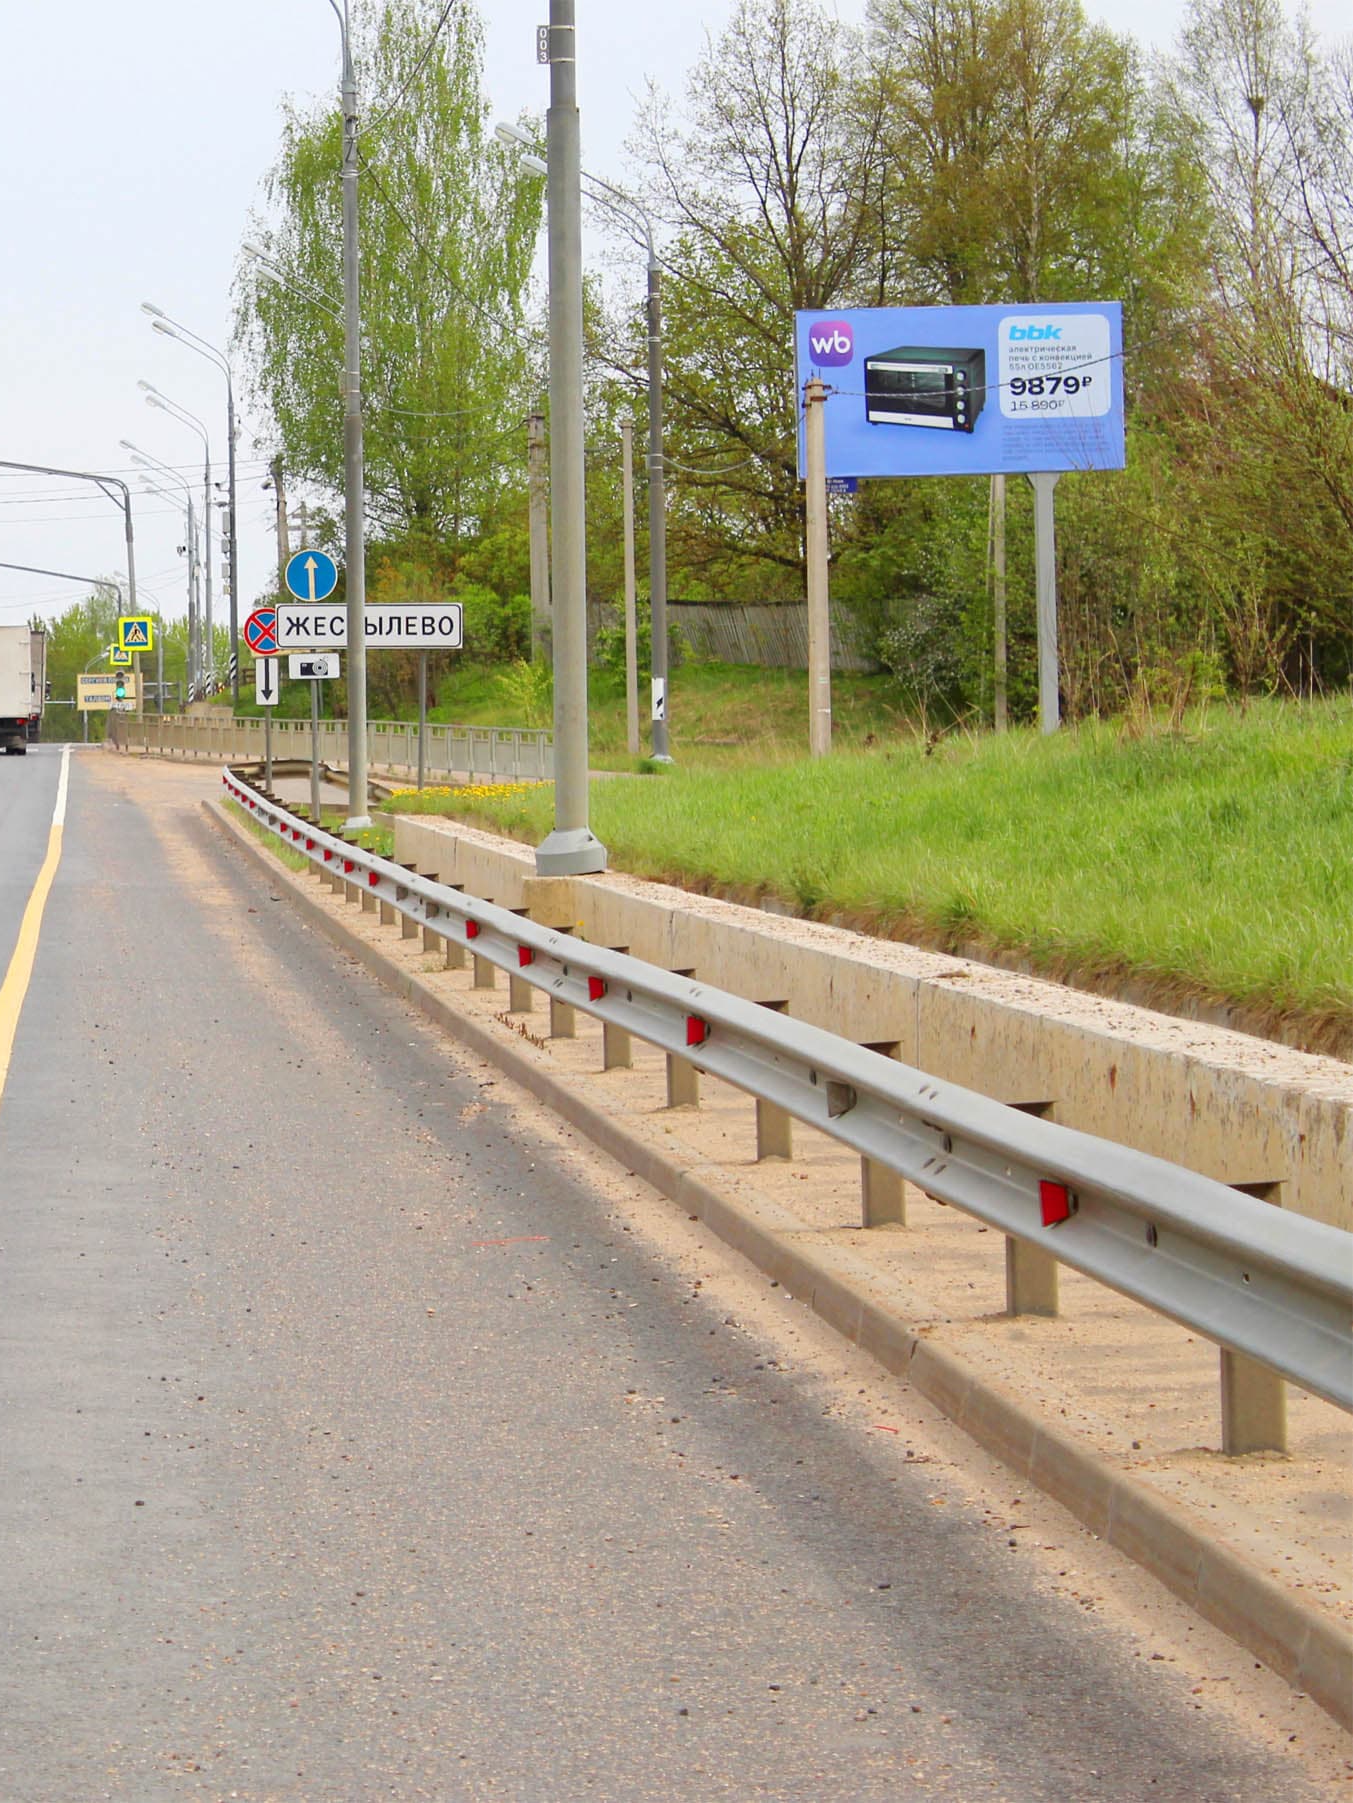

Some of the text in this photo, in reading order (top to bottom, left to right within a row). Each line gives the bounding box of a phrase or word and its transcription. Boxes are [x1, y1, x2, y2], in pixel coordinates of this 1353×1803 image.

[811, 330, 851, 354] wb
[1009, 325, 1063, 341] bbk
[285, 615, 454, 637] ЖЕСЫЛЕВО
